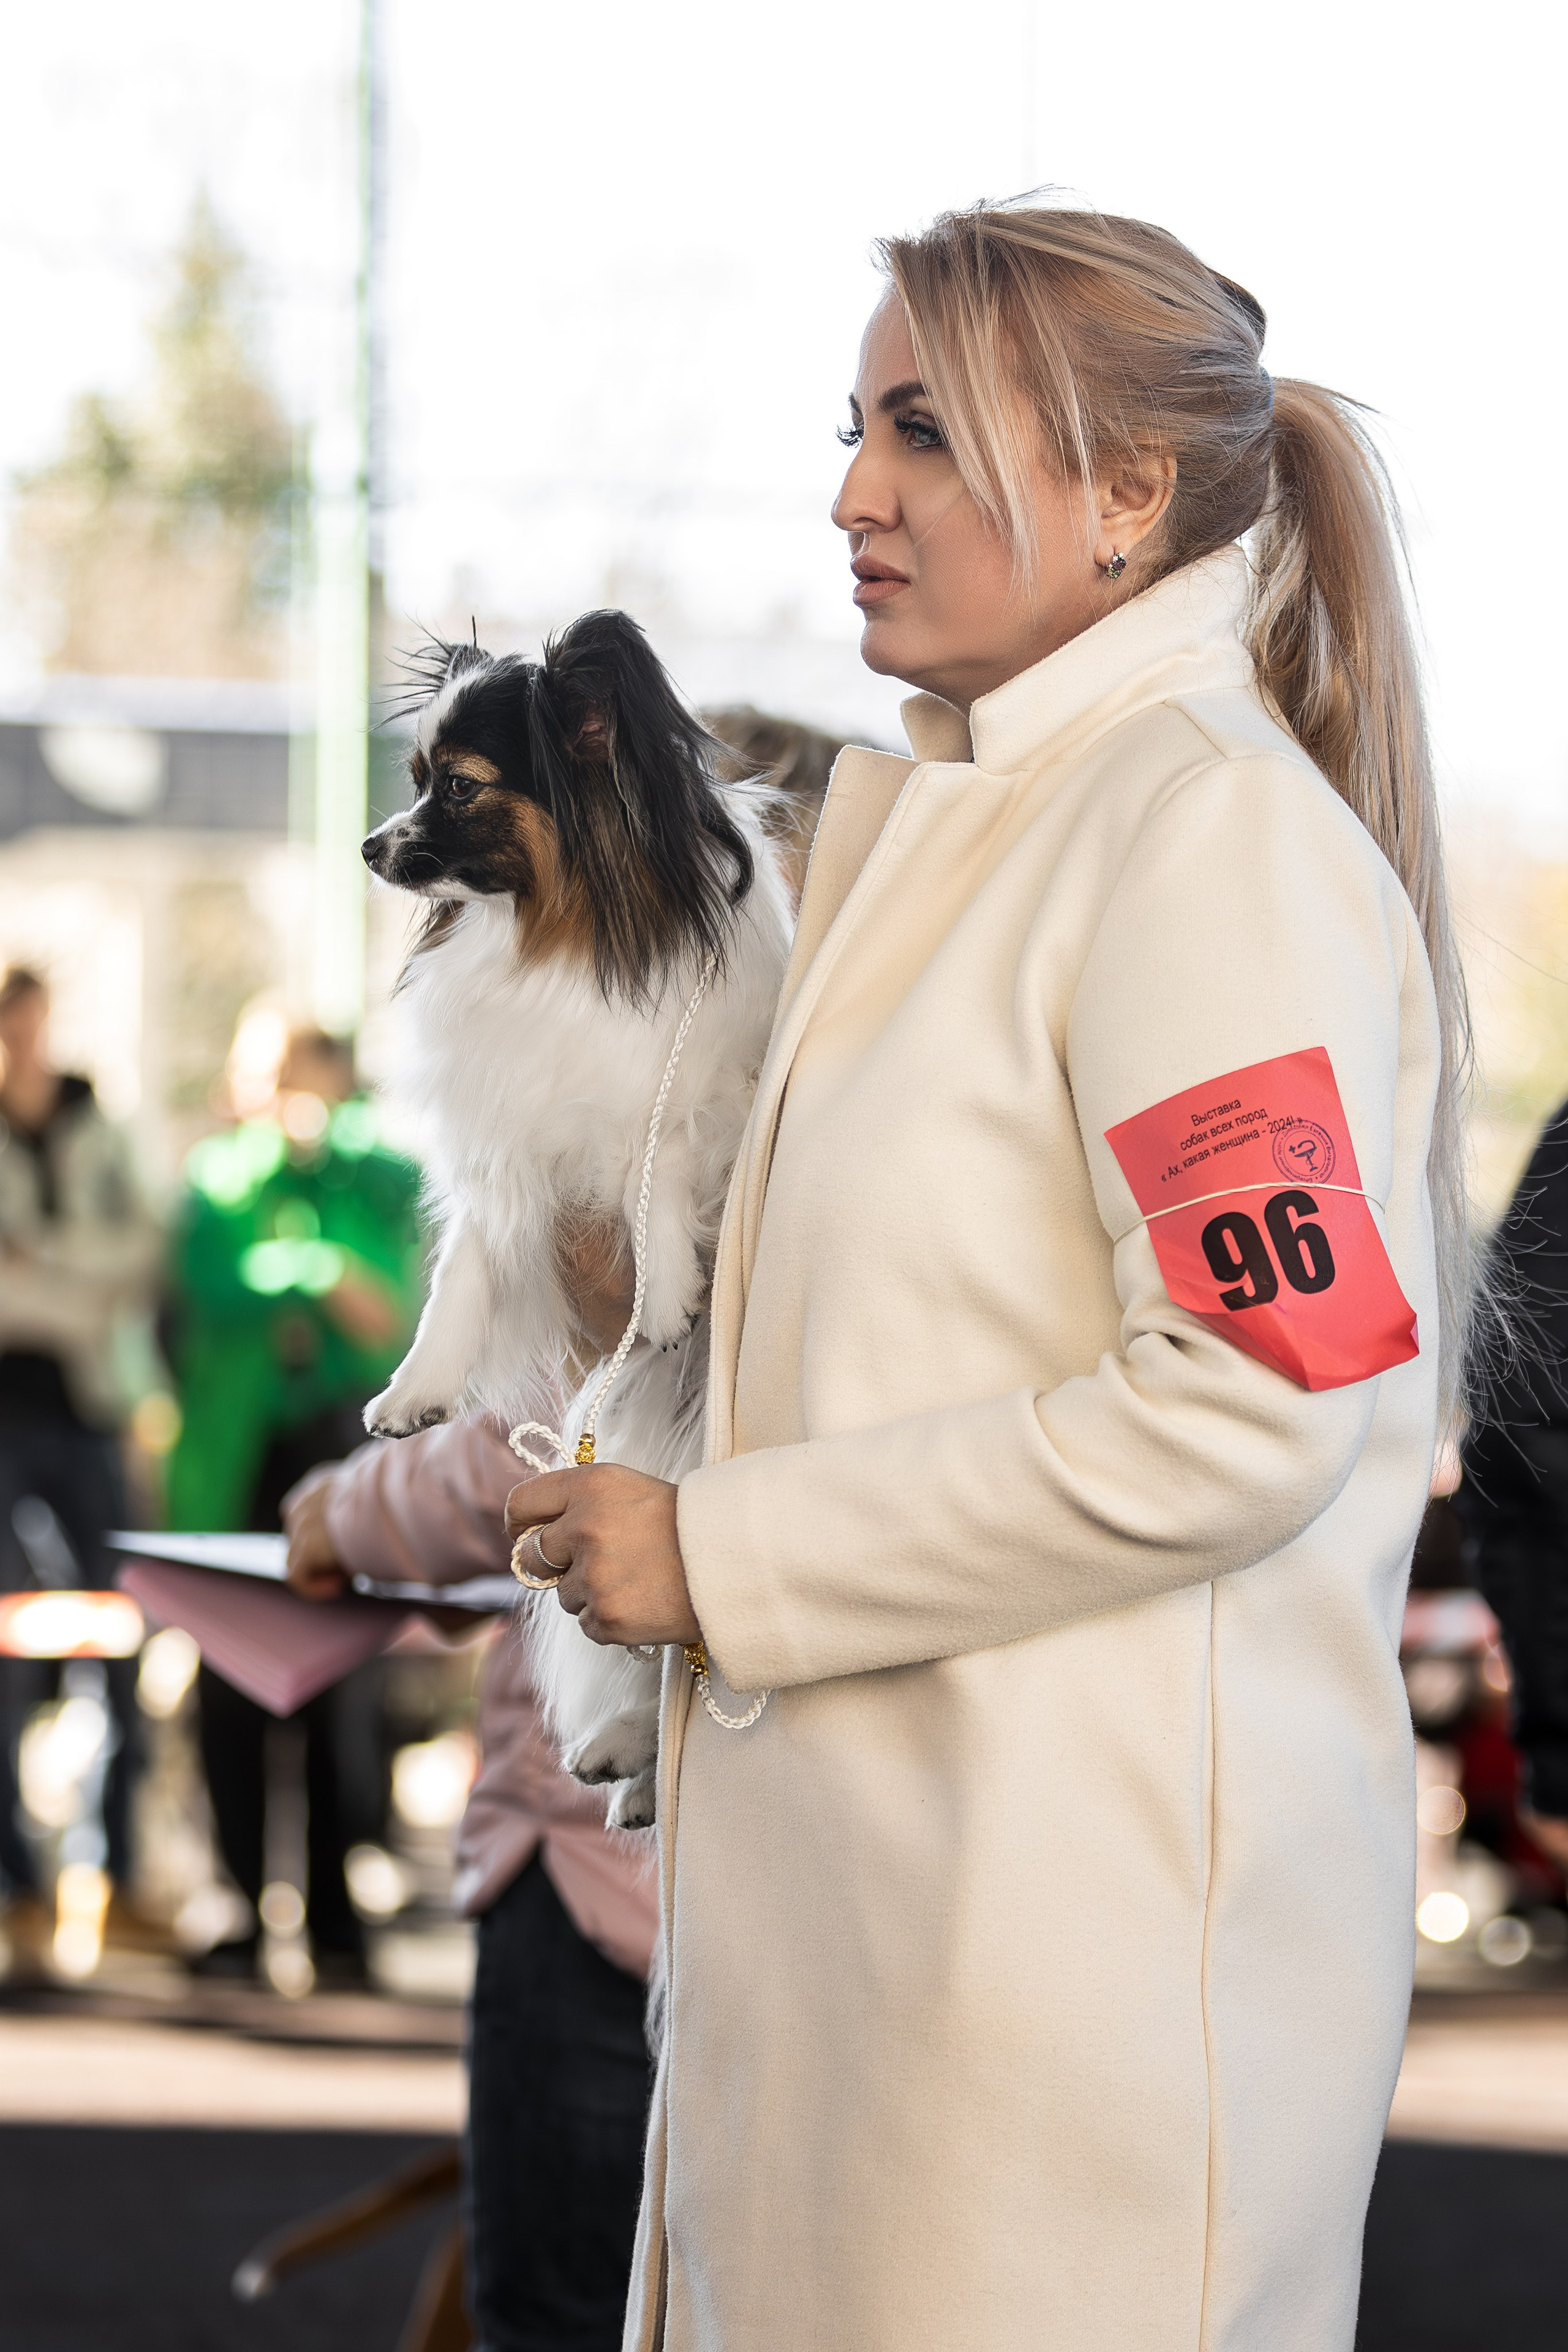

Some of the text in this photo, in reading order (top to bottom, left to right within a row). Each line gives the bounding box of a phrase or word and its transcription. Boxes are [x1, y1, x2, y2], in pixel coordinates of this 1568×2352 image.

[1180, 1109, 1268, 1151] собак всех пород
[1191, 1099, 1242, 1126] Выставка
[1183, 1149, 1211, 1169] какая
[1211, 1131, 1260, 1156] женщина
[1201, 1190, 1336, 1312] 96
